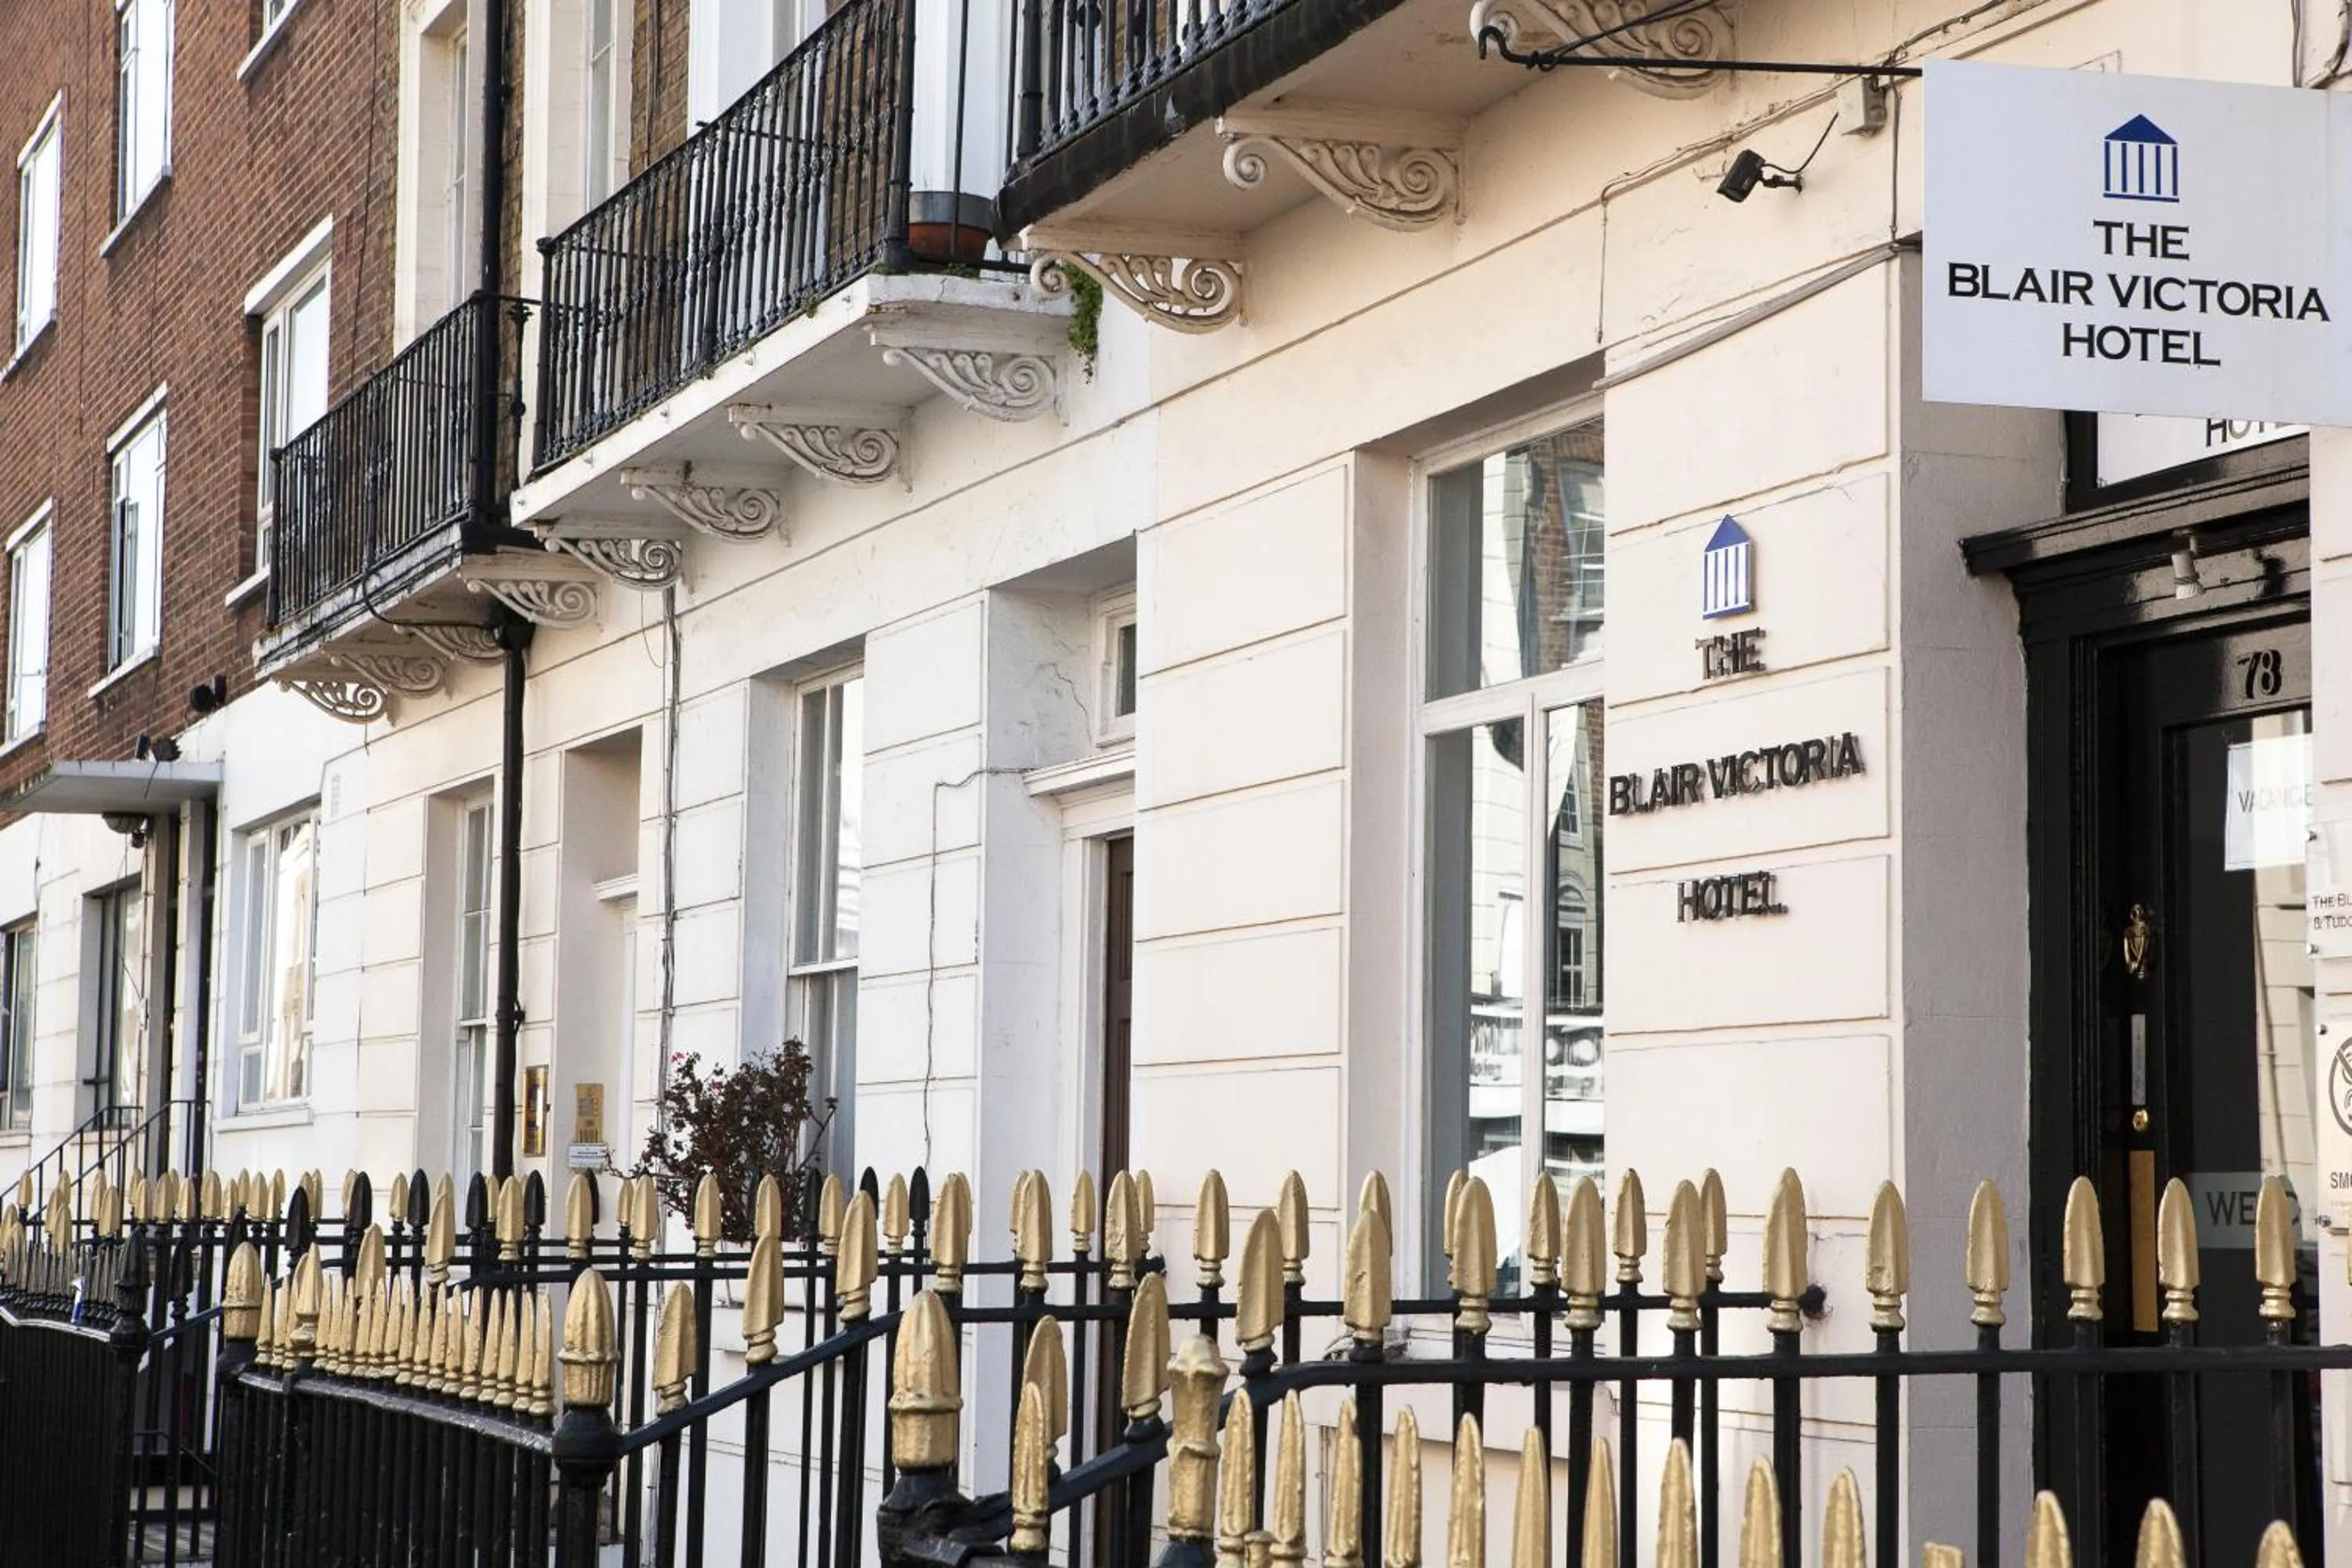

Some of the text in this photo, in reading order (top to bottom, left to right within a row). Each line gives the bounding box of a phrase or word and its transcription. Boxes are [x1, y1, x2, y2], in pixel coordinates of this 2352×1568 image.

[2092, 219, 2190, 261] THE
[1947, 261, 2332, 323] BLAIR VICTORIA
[2062, 322, 2221, 367] HOTEL
[1694, 626, 1767, 680] THE
[2236, 648, 2282, 699] 78
[1609, 731, 1866, 816] BLAIR VICTORIA
[1677, 870, 1789, 923] HOTEL
[2312, 895, 2336, 909] THE
[2330, 1171, 2352, 1189] SM
